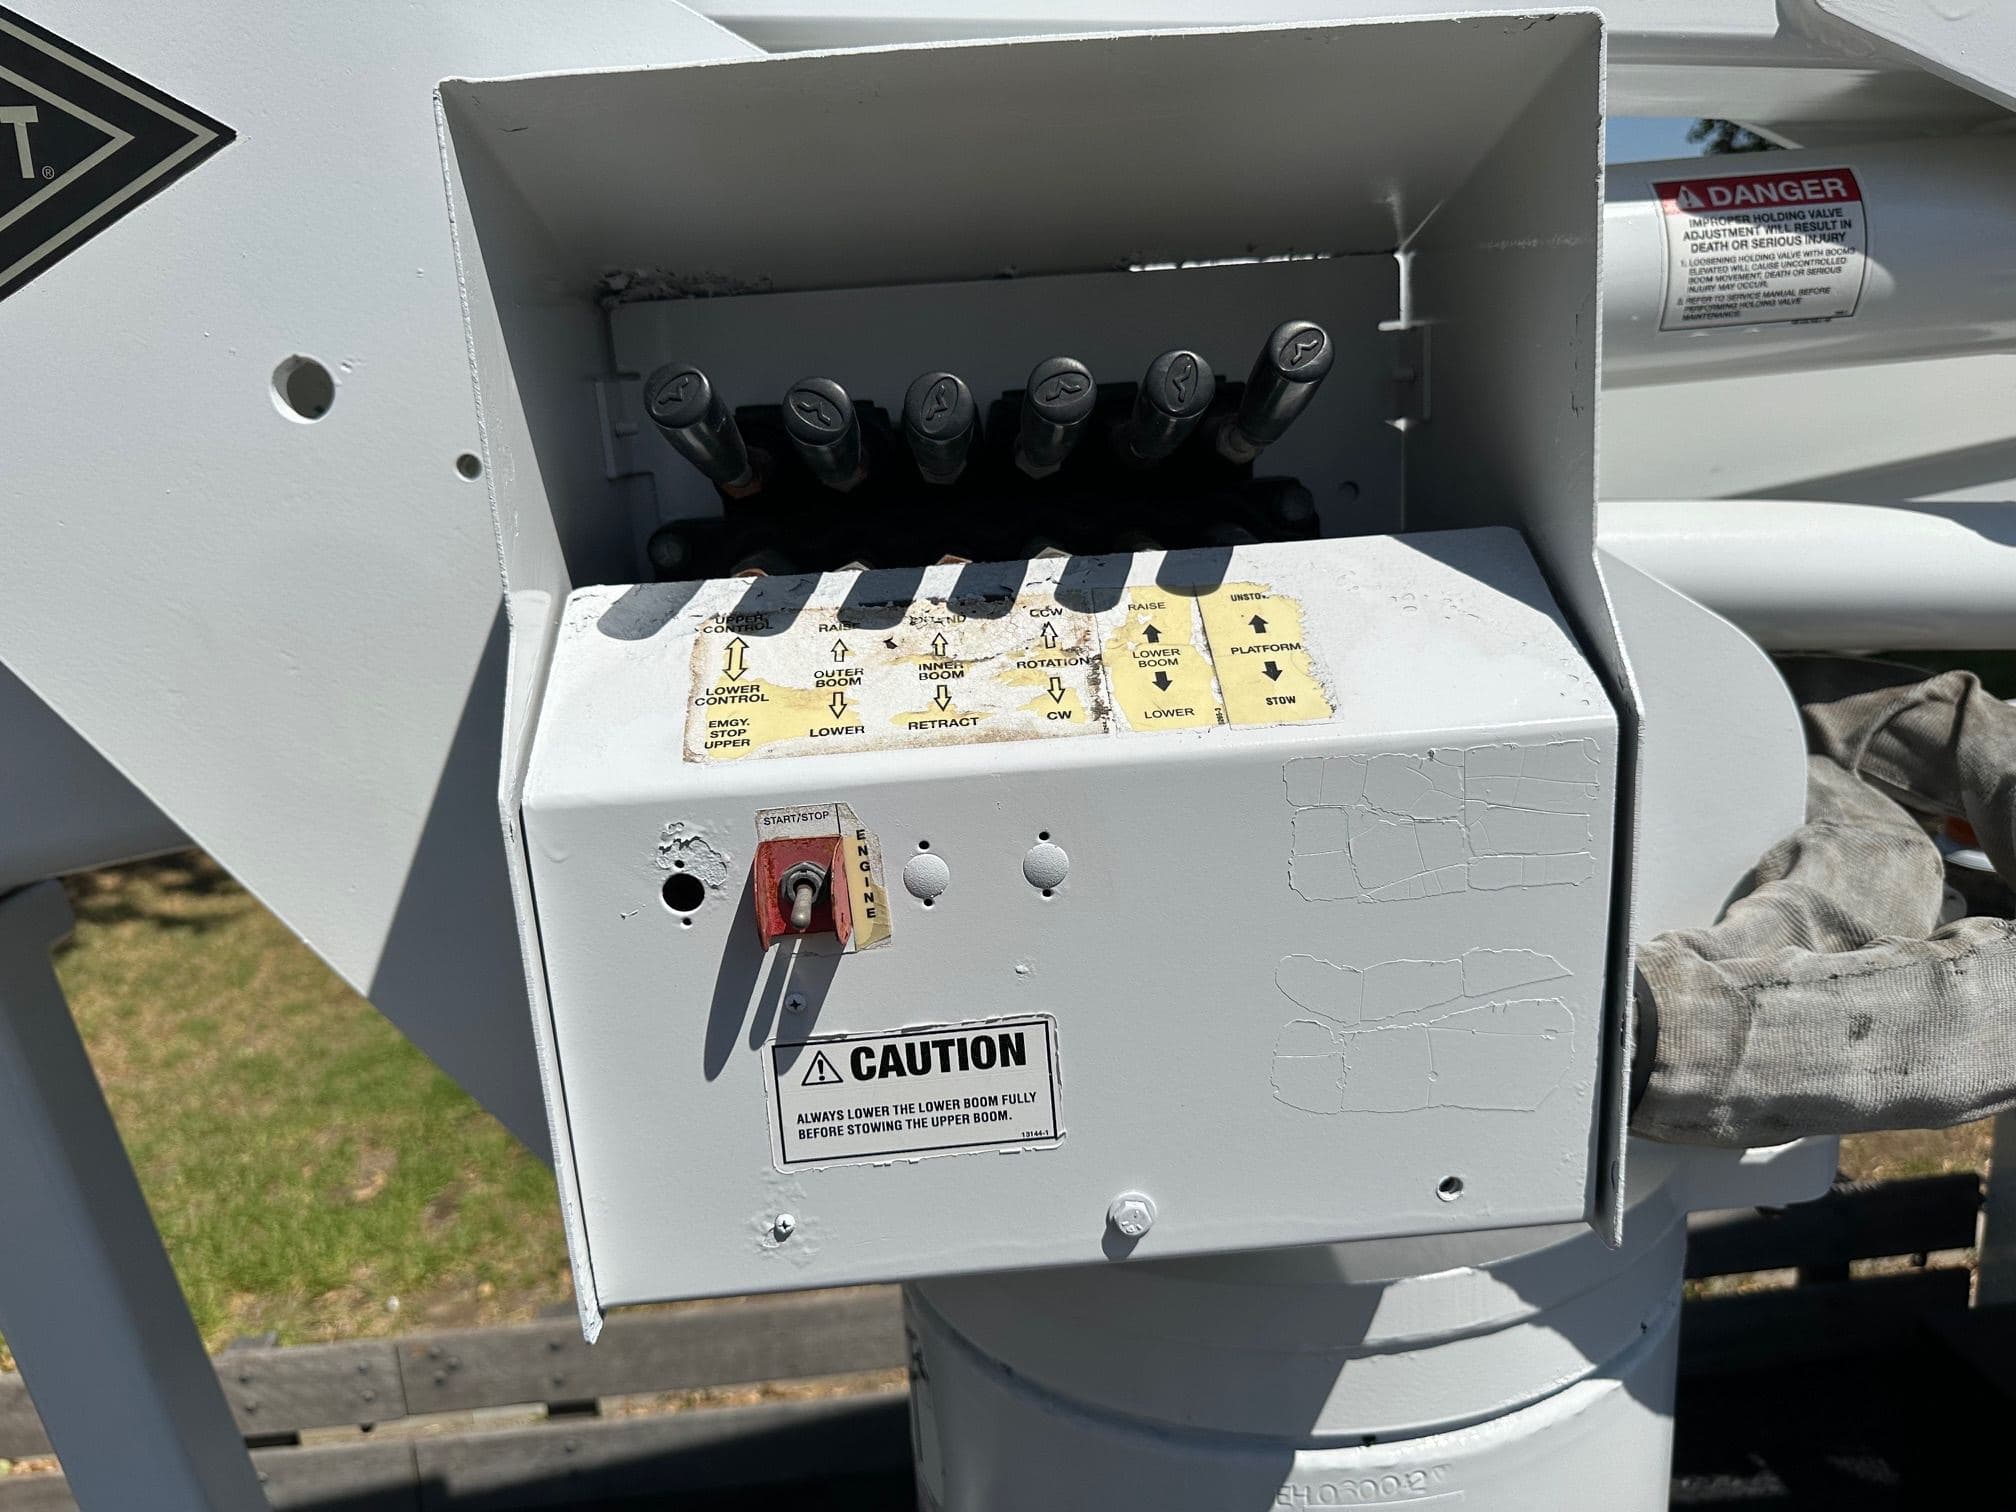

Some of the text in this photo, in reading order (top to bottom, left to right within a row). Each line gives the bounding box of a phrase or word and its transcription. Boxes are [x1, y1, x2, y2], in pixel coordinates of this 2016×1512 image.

[1707, 178, 1848, 207] DANGER
[1689, 208, 1843, 228] IMPROPER HOLDING VALVE
[1683, 219, 1852, 241] ADJUSTMENT WILL RESULT IN
[1690, 232, 1846, 253] DEATH OR SERIOUS INJURY
[1688, 256, 1736, 267] LOOSENING
[1737, 254, 1775, 263] HOLDING
[1777, 251, 1801, 260] VALVE
[1803, 249, 1824, 257] WITH
[1688, 257, 1847, 276] ELEVATED WILL CAUSE UNCONTROLLED
[1764, 270, 1791, 280] DEATH
[1793, 269, 1805, 277] OR
[1806, 266, 1842, 276] SERIOUS
[1719, 282, 1735, 291] MAY
[1762, 288, 1796, 298] MANUAL
[1128, 601, 1166, 611] RAISE
[1029, 608, 1063, 618] CCW
[715, 614, 763, 625] UPPER
[703, 619, 773, 633] CONTROL
[819, 622, 861, 633] RAISE
[1132, 648, 1181, 660] LOWER
[1231, 642, 1301, 655] PLATFORM
[919, 661, 964, 672] INNER
[1017, 657, 1091, 669] ROTATION
[1138, 658, 1179, 668] BOOM
[814, 668, 864, 679] OUTER
[919, 670, 965, 681] BOOM
[815, 677, 862, 688] BOOM
[706, 684, 760, 696] LOWER
[695, 693, 769, 707] CONTROL
[1266, 696, 1296, 706] STOW
[1047, 710, 1072, 720] CW
[1144, 708, 1194, 720] LOWER
[708, 718, 750, 729] EMGY.
[908, 717, 979, 730] RETRACT
[710, 728, 747, 739] STOP
[810, 725, 865, 738] LOWER
[704, 738, 751, 750] UPPER
[764, 811, 829, 826] START/STOP
[856, 829, 876, 919] ENGINE
[850, 1032, 1026, 1081] CAUTION
[797, 1092, 1037, 1125] ALWAYS LOWER THE LOWER BOOM FULLY
[799, 1110, 1012, 1140] BEFORE STOWING THE UPPER BOOM.
[1021, 1130, 1049, 1138] 13144-1
